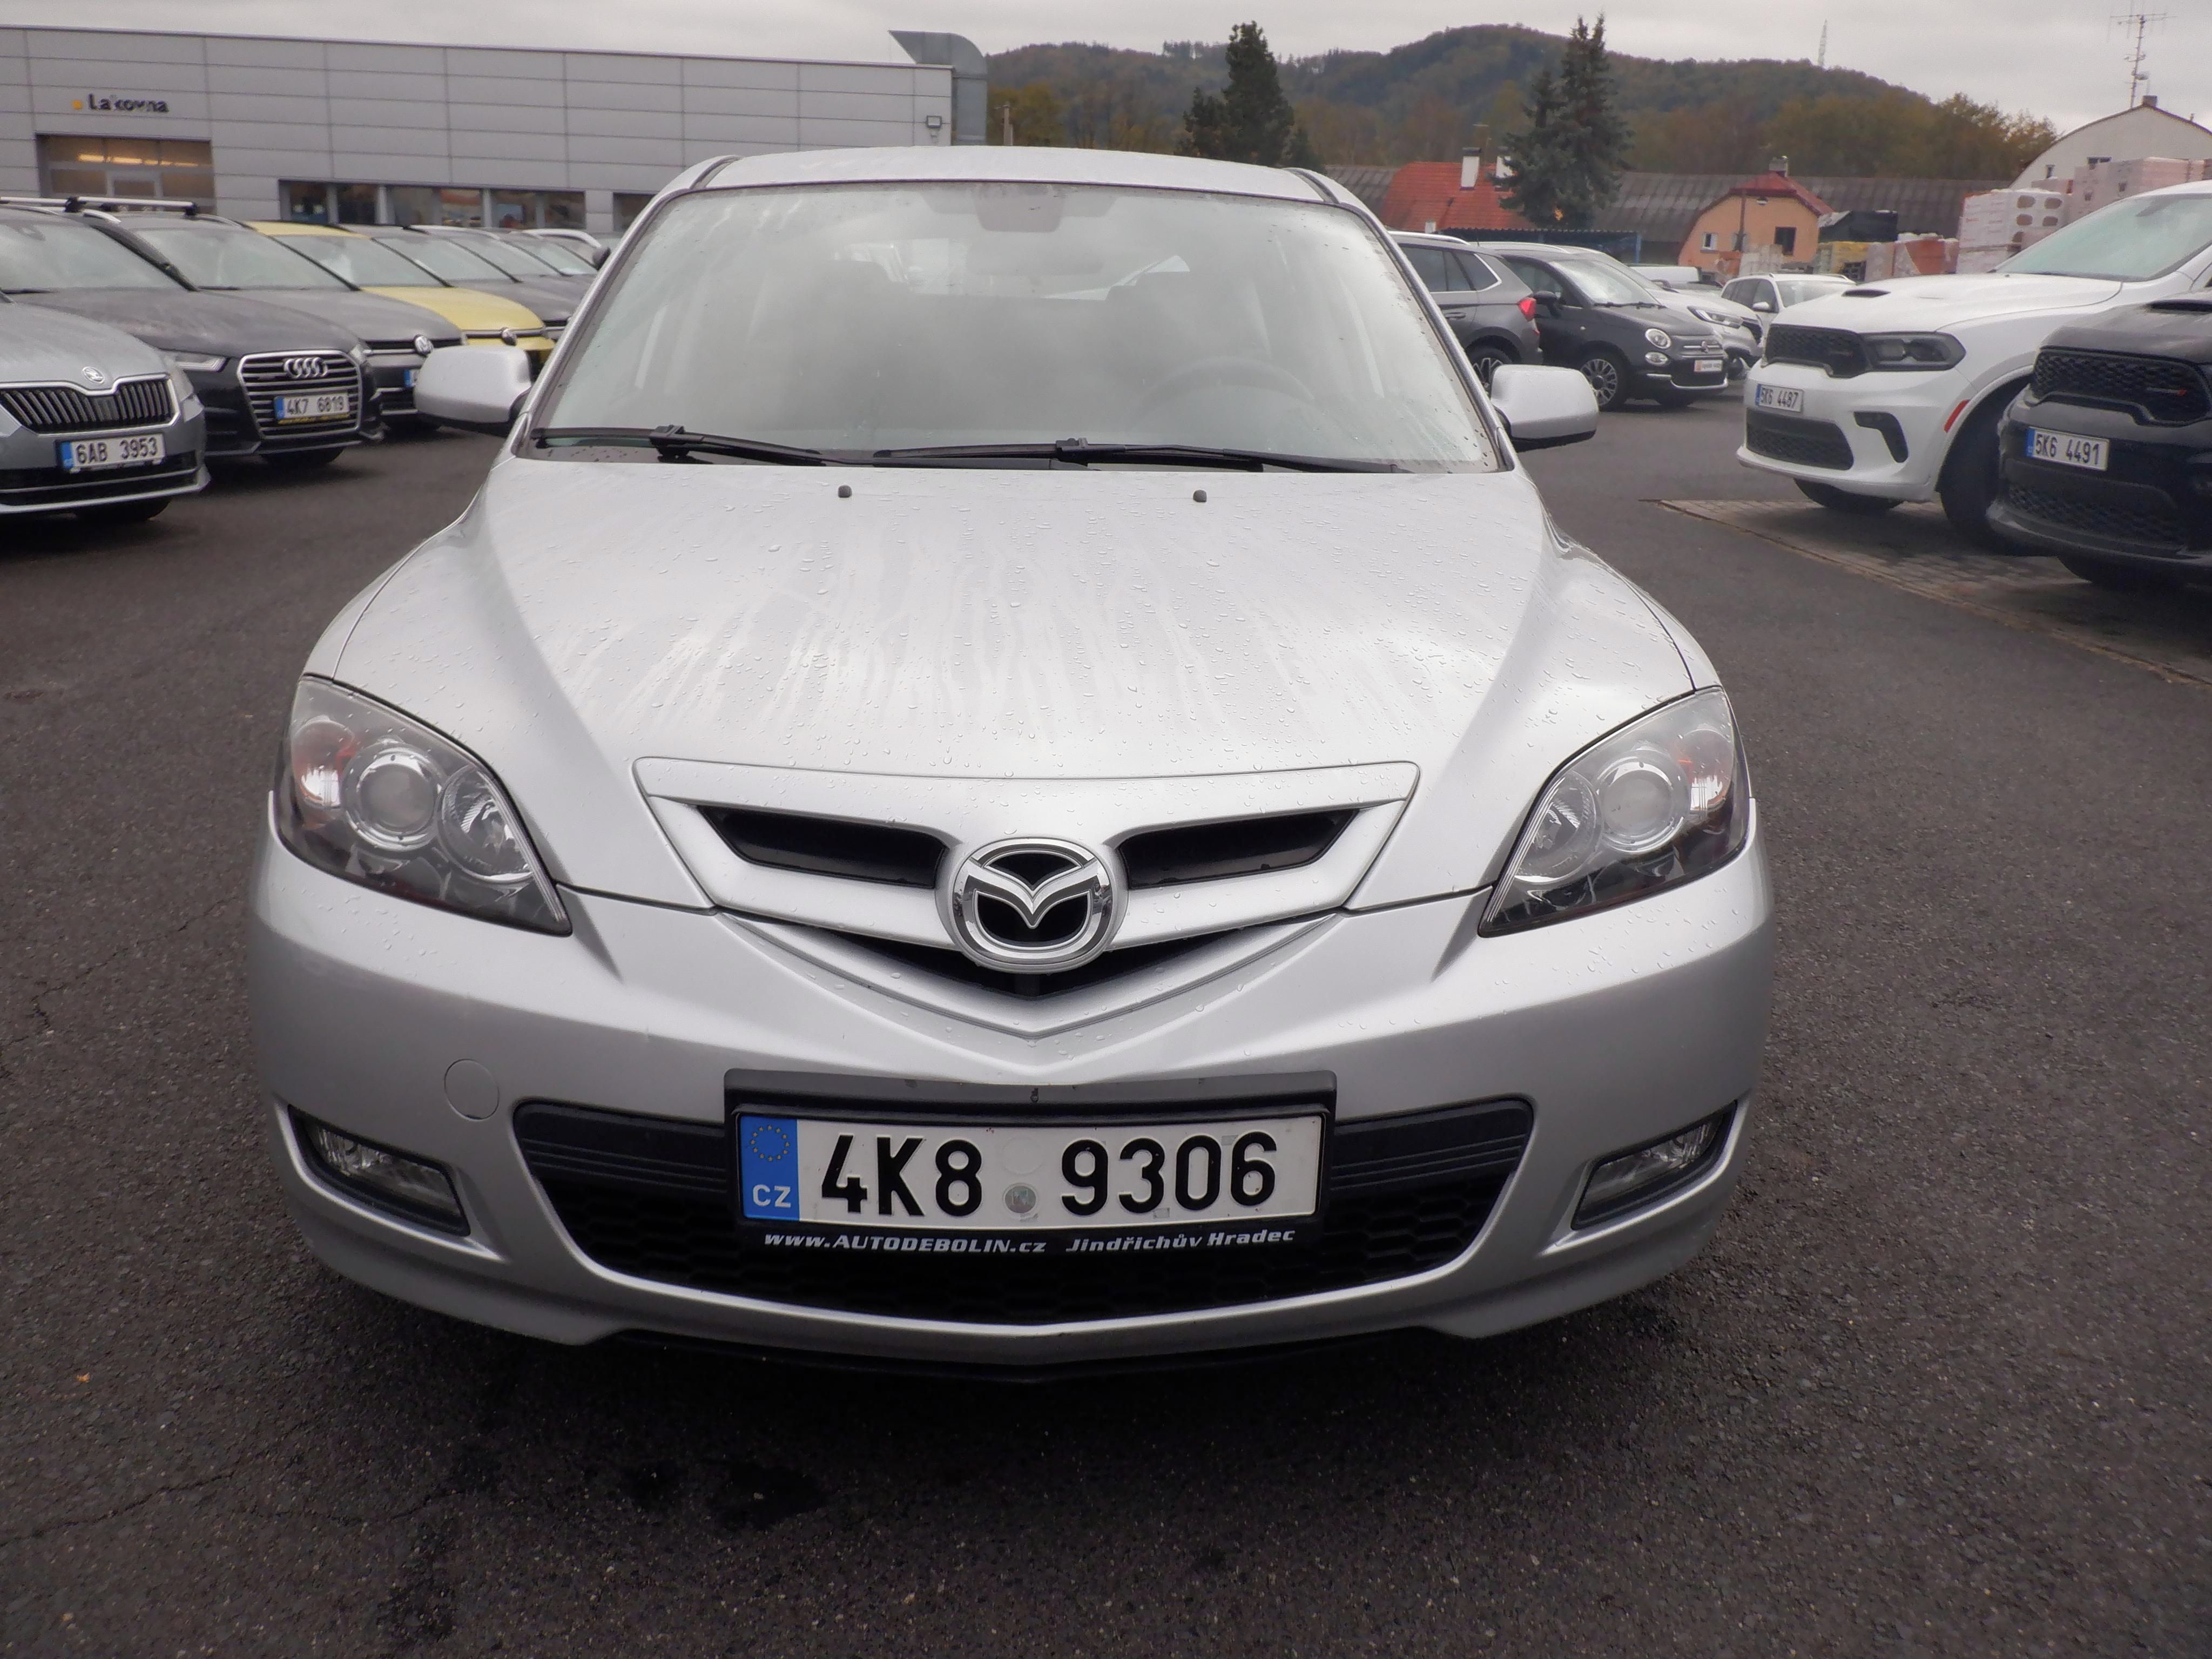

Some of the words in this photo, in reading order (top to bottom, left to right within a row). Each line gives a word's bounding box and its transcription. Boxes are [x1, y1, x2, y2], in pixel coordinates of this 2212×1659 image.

[287, 398, 309, 415] 4K7
[76, 441, 107, 464] 6AB
[119, 436, 158, 459] 3953
[2035, 433, 2058, 457] 5K6
[2066, 439, 2100, 466] 4491
[752, 1184, 792, 1209] CZ
[821, 1134, 982, 1217] 4K8
[1061, 1130, 1277, 1217] 9306
[764, 1233, 1047, 1254] www.AUTODEBOLIN.cz
[1065, 1233, 1203, 1252] Jindřichův
[1206, 1229, 1296, 1246] Hradec
